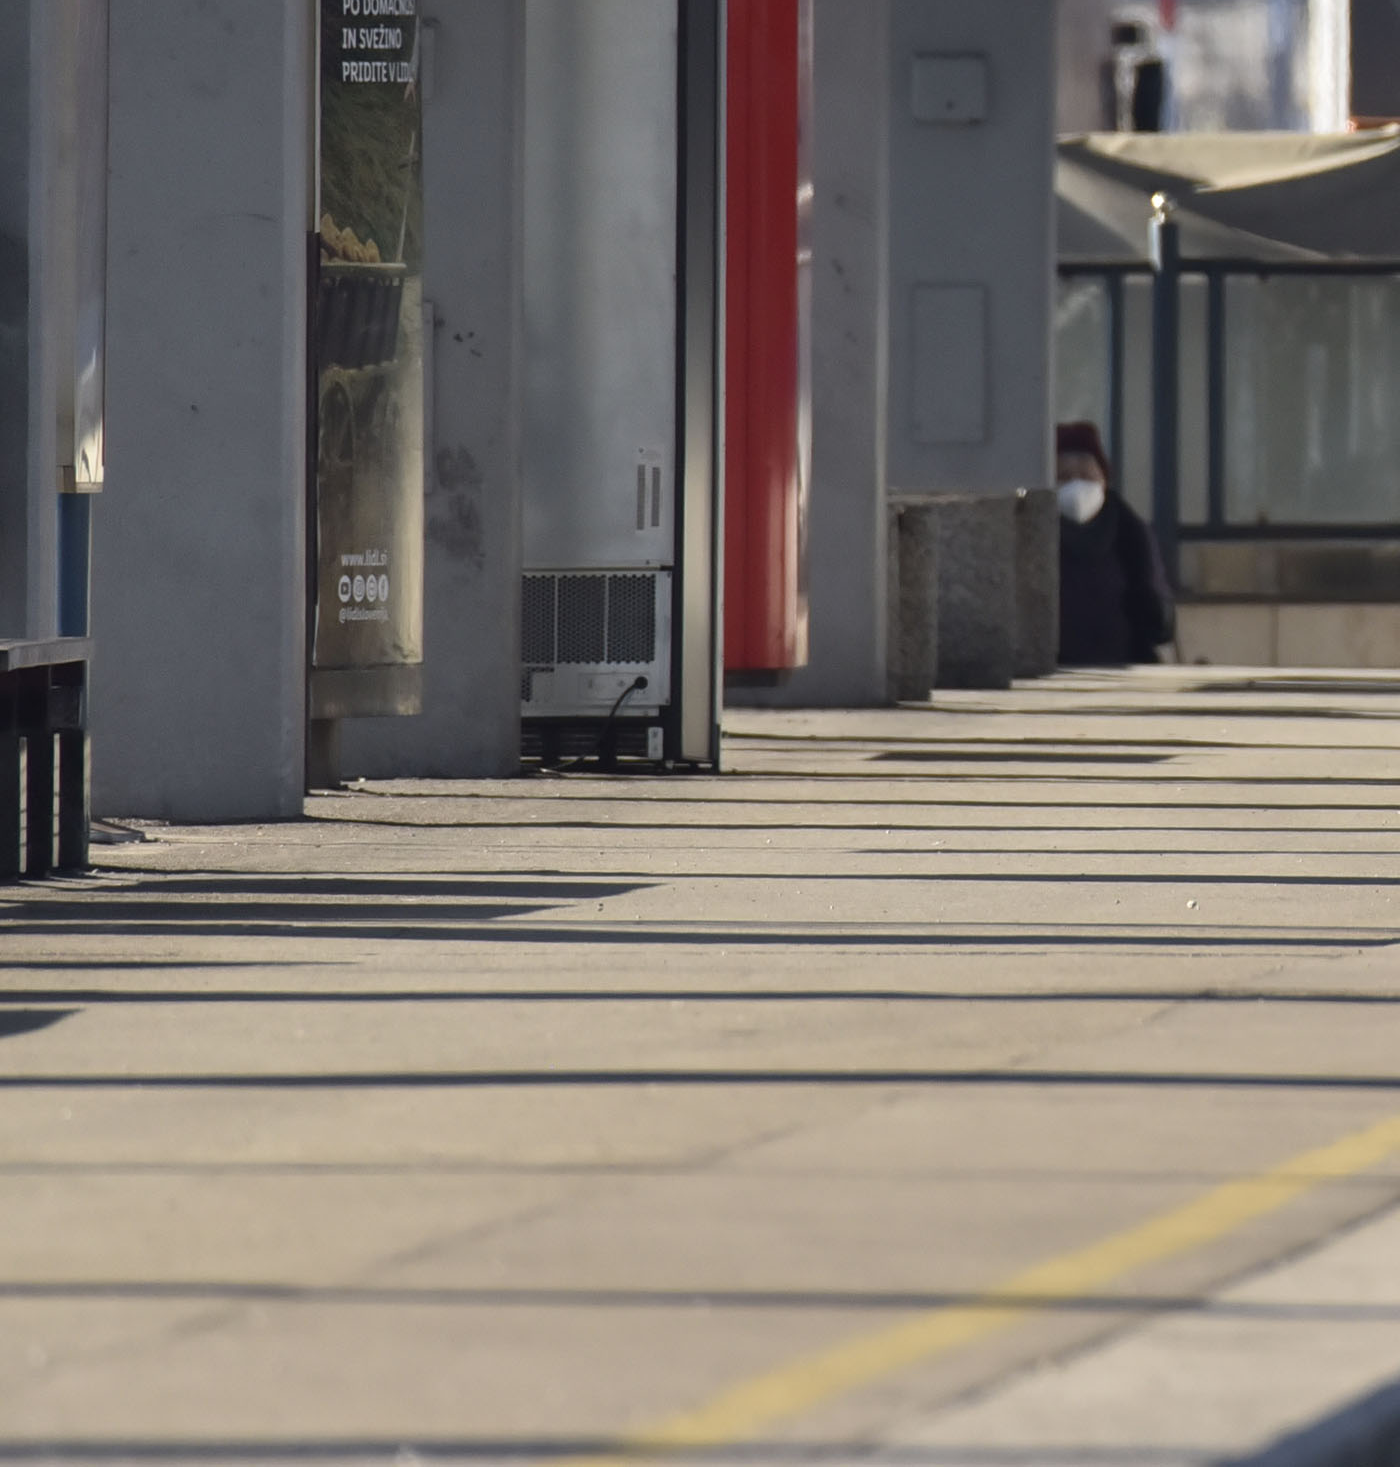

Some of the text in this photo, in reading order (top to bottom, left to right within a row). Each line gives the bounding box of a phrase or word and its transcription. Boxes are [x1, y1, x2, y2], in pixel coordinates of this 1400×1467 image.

[342, 23, 402, 49] IN SVEŽINO
[342, 61, 388, 83] PRIDITE
